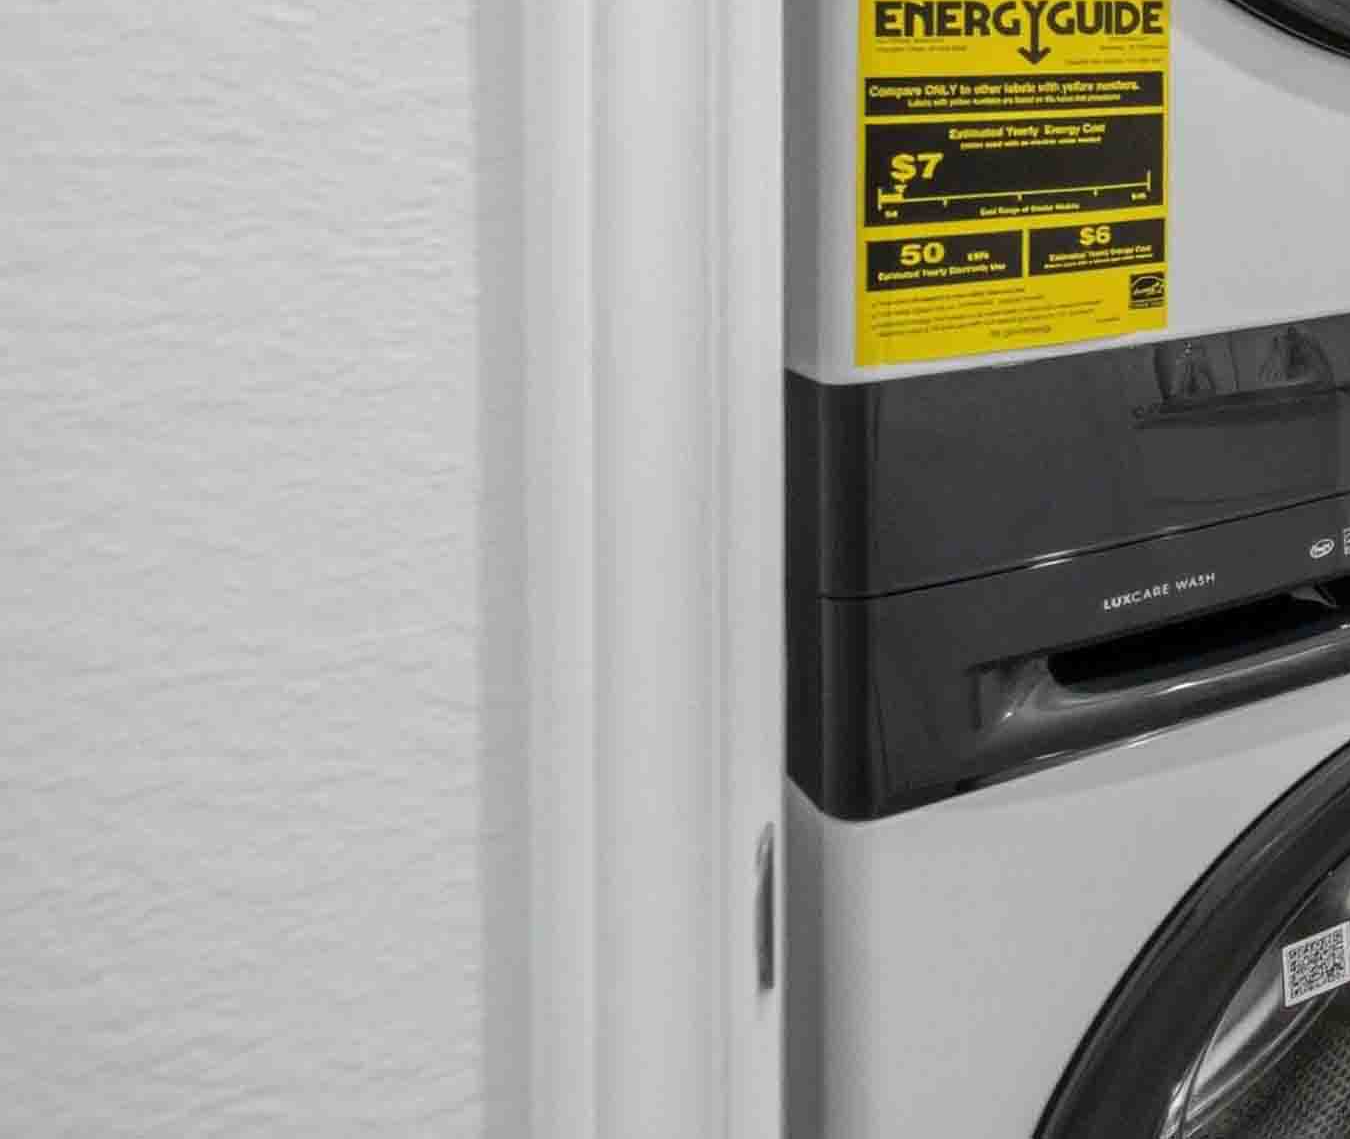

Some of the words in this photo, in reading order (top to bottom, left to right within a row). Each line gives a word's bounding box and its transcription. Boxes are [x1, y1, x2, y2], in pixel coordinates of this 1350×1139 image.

[875, 0, 1165, 39] ENERGYGUIDE
[924, 83, 958, 96] ONLY
[890, 151, 945, 181] $7
[1079, 224, 1111, 246] $6
[900, 242, 945, 266] 50
[1103, 583, 1169, 611] LUXCARE
[1176, 572, 1216, 592] WASH
